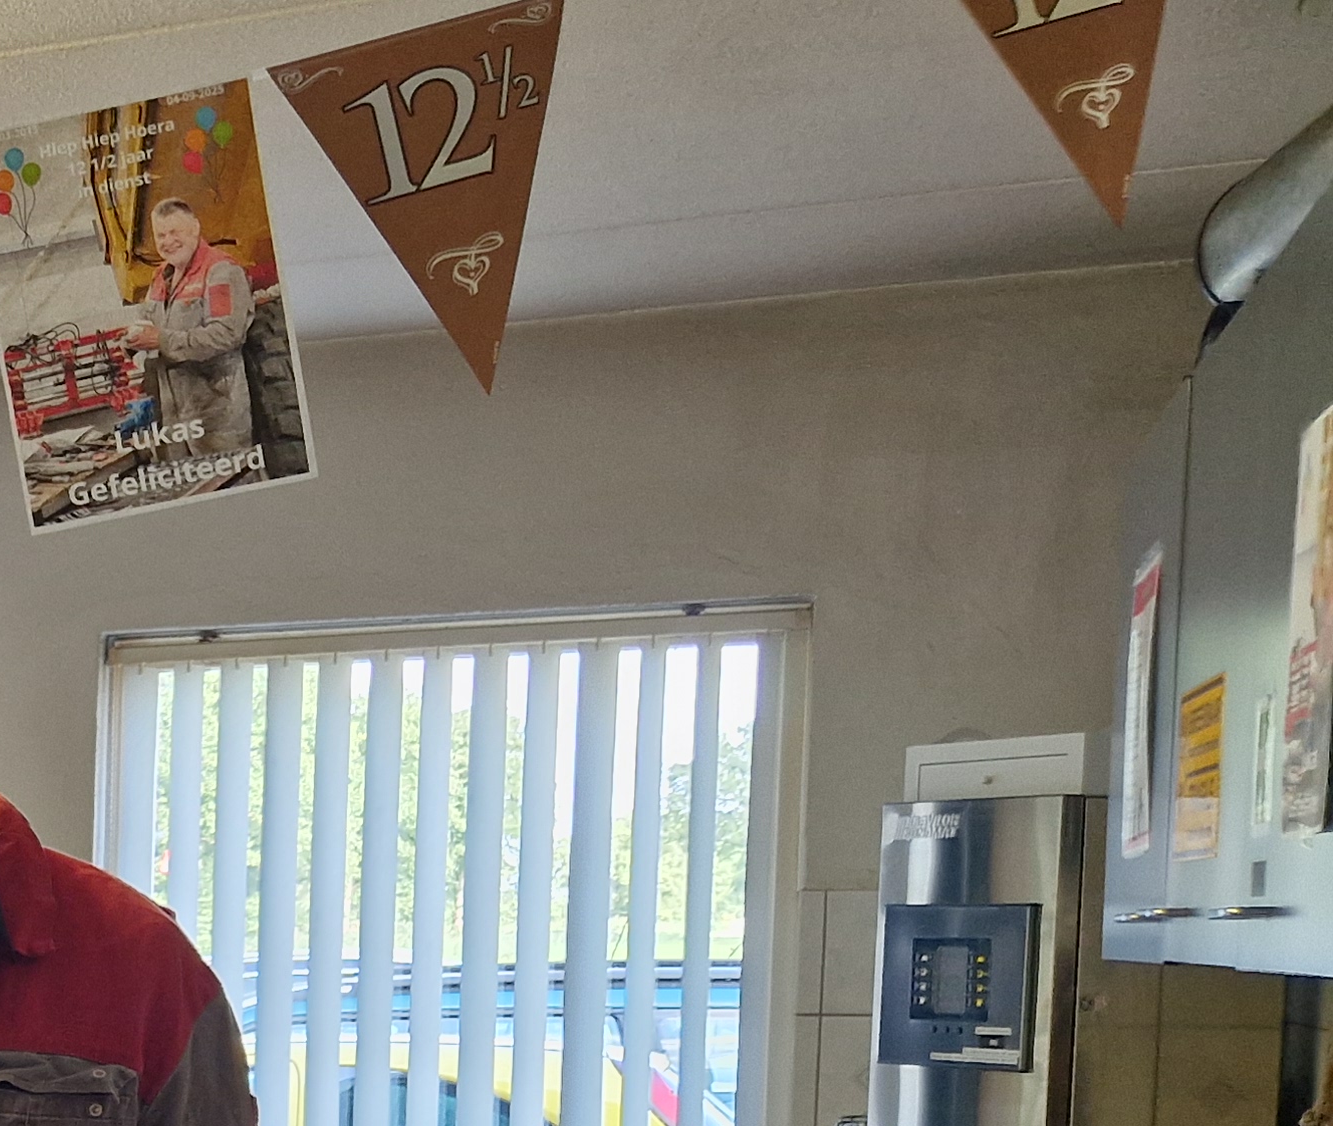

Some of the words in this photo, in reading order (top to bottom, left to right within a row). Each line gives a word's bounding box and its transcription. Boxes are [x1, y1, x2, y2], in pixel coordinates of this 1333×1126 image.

[40, 142, 77, 159] Hiep
[82, 133, 120, 149] Hiep
[124, 119, 175, 140] Hoera
[342, 65, 496, 206] 12
[91, 154, 117, 171] 1/2
[119, 148, 154, 170] jaar
[98, 172, 151, 194] dienst
[115, 417, 206, 451] Lukas
[69, 444, 265, 506] Gefeliciteerd
